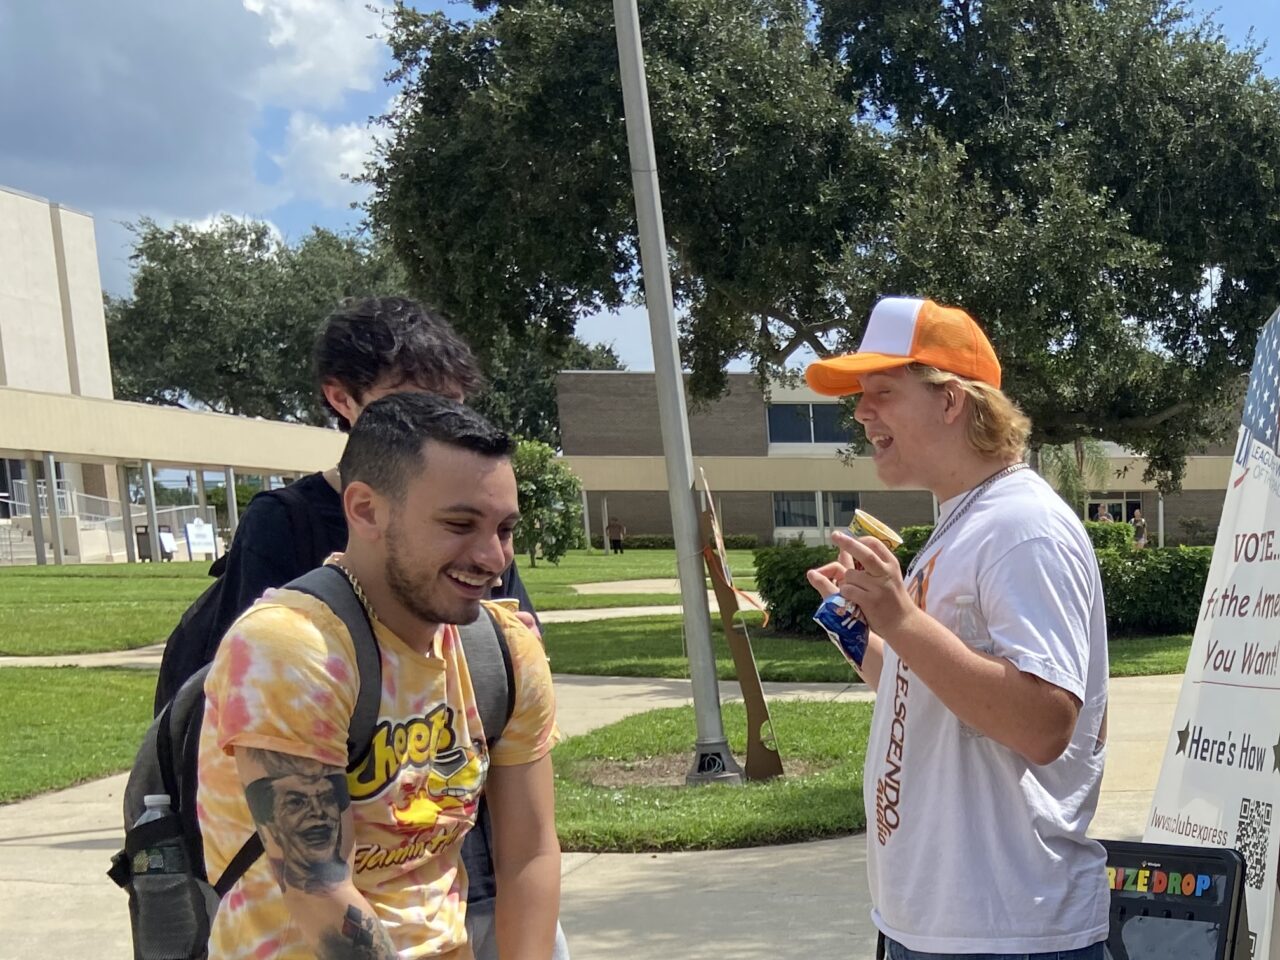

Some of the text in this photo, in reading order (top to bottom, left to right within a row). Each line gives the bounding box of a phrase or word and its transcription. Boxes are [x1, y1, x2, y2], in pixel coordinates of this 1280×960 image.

[1219, 584, 1251, 618] the
[1203, 640, 1280, 676] You Want!
[1188, 725, 1267, 772] Here's How
[1152, 870, 1211, 897] DROP
